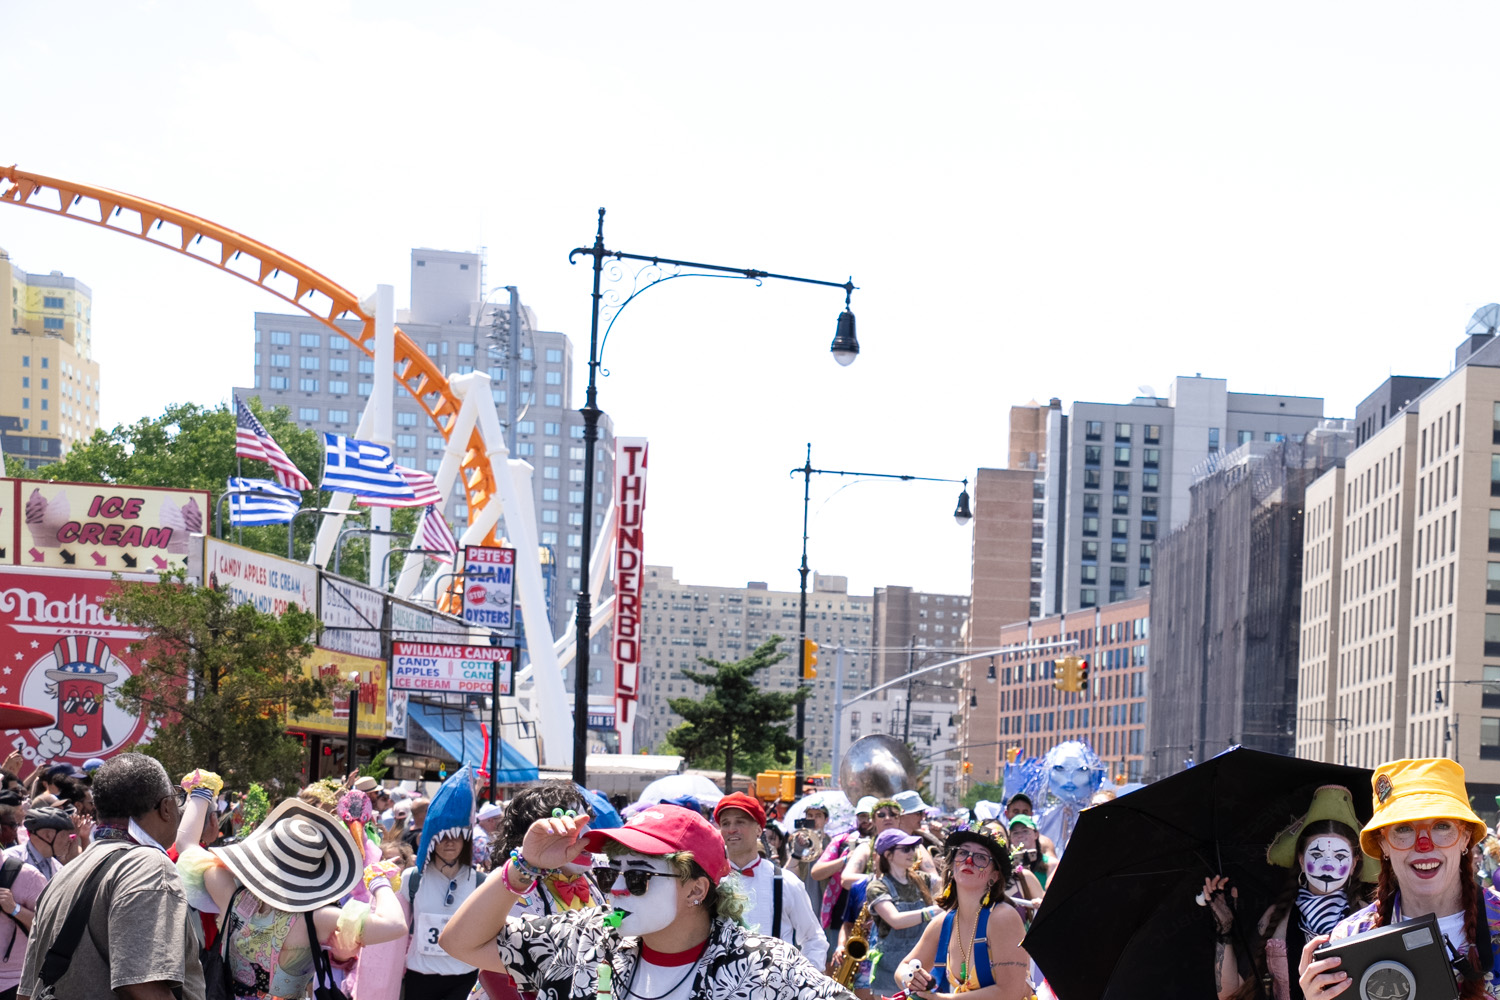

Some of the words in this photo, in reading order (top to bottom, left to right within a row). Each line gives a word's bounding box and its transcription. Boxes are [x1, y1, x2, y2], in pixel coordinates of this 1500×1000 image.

[88, 495, 145, 519] ICE
[57, 521, 173, 549] CREAM
[469, 549, 512, 563] PETE'S
[220, 555, 242, 577] CANDY
[244, 564, 267, 586] APPLES
[269, 569, 278, 588] ICE
[280, 573, 301, 594] CREAM
[467, 564, 511, 584] CLAM
[616, 446, 643, 723] THUNDERBOLT
[468, 590, 486, 600] STOP
[466, 608, 510, 624] OYSTERS
[56, 628, 111, 636] FAMOUS
[400, 643, 462, 658] WILLIAMS
[465, 648, 511, 661] CANDY
[398, 657, 438, 667] CANDY
[396, 667, 440, 677] APPLES
[463, 670, 503, 680] CAND
[395, 678, 413, 688] ICE
[414, 679, 450, 689] CREAM
[459, 682, 508, 692] POPCON
